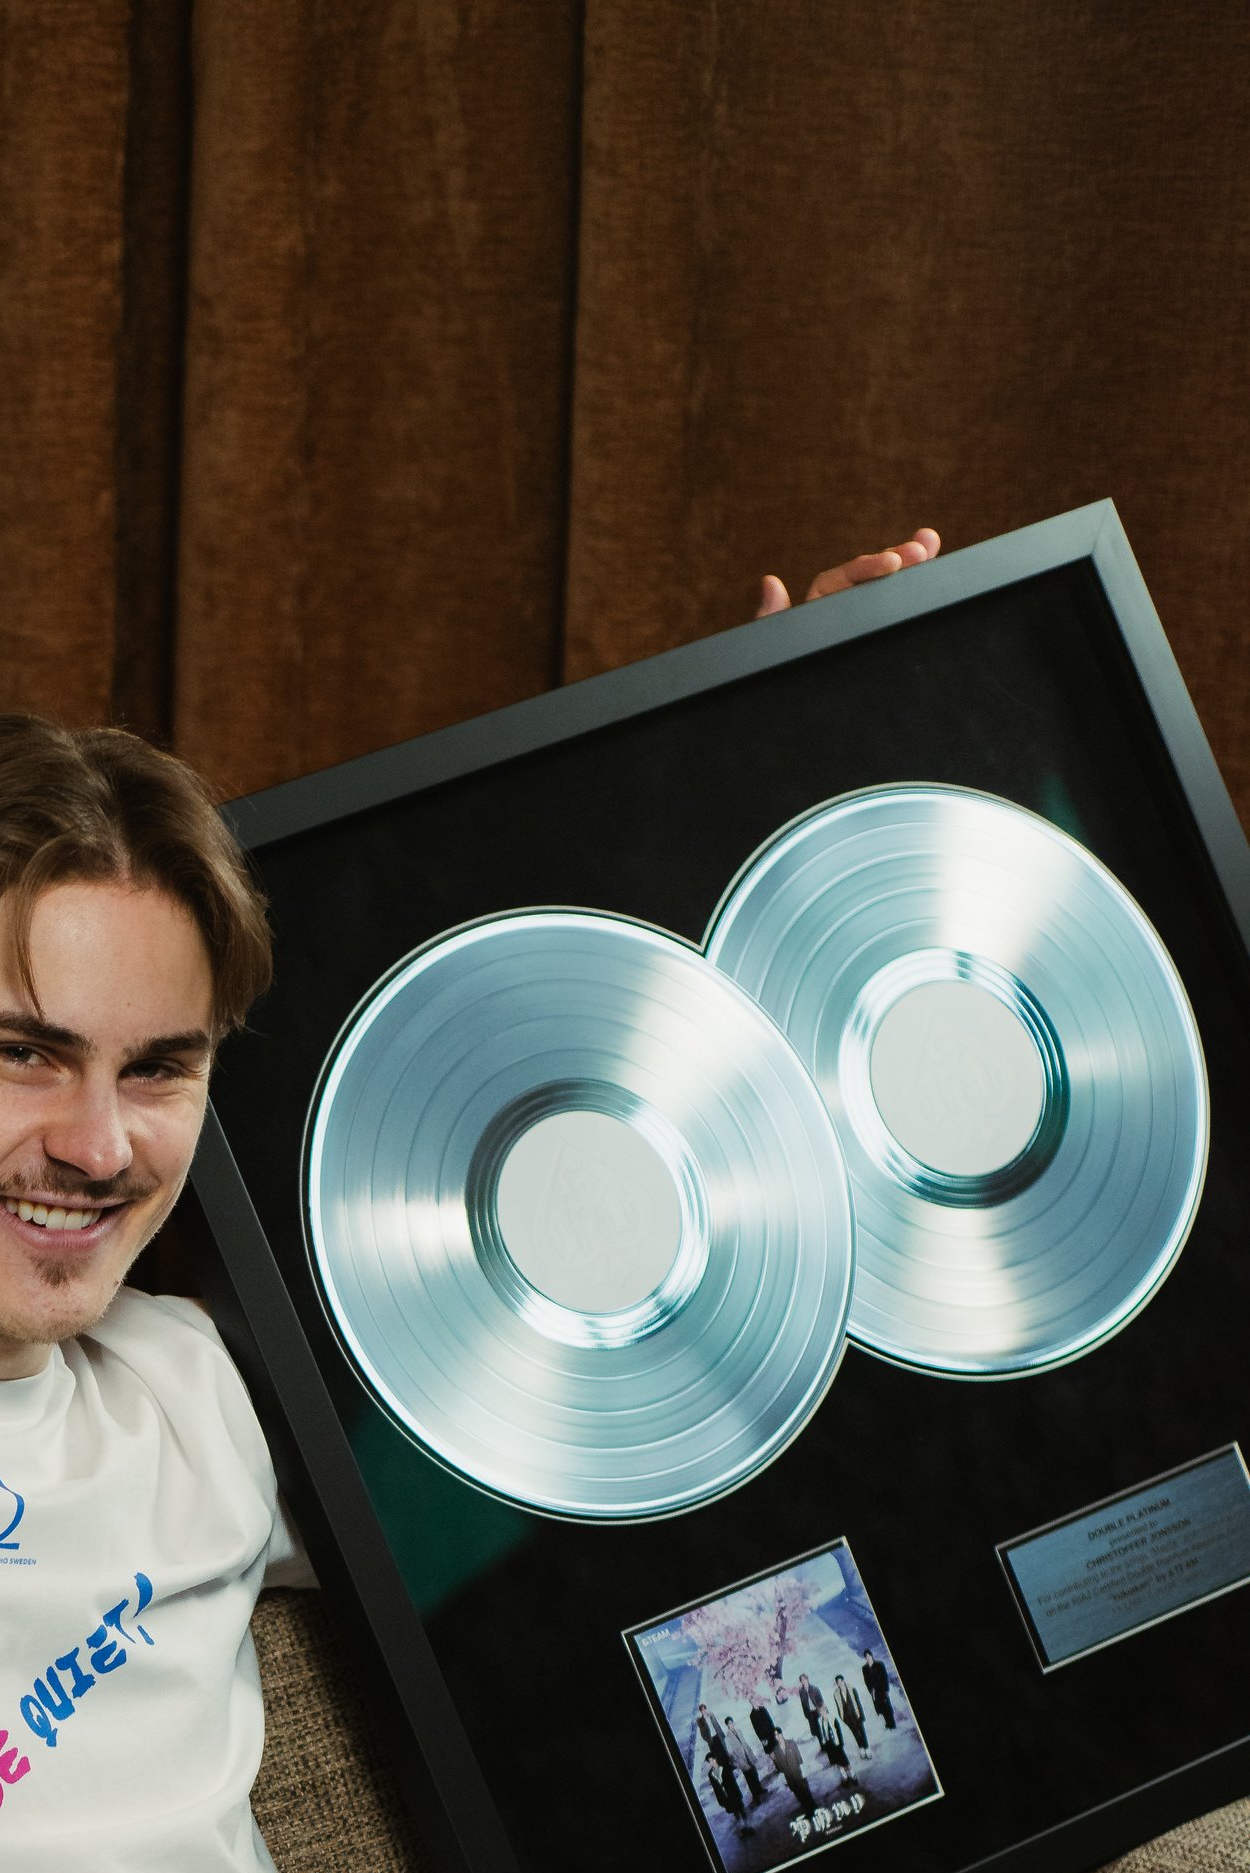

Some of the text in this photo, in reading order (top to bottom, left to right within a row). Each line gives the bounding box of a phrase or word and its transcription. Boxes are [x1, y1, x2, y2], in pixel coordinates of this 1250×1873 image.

[1087, 1518, 1123, 1540] DOUBLE
[1125, 1497, 1170, 1522] PLATINUM
[9, 1558, 36, 1566] SWEDEN
